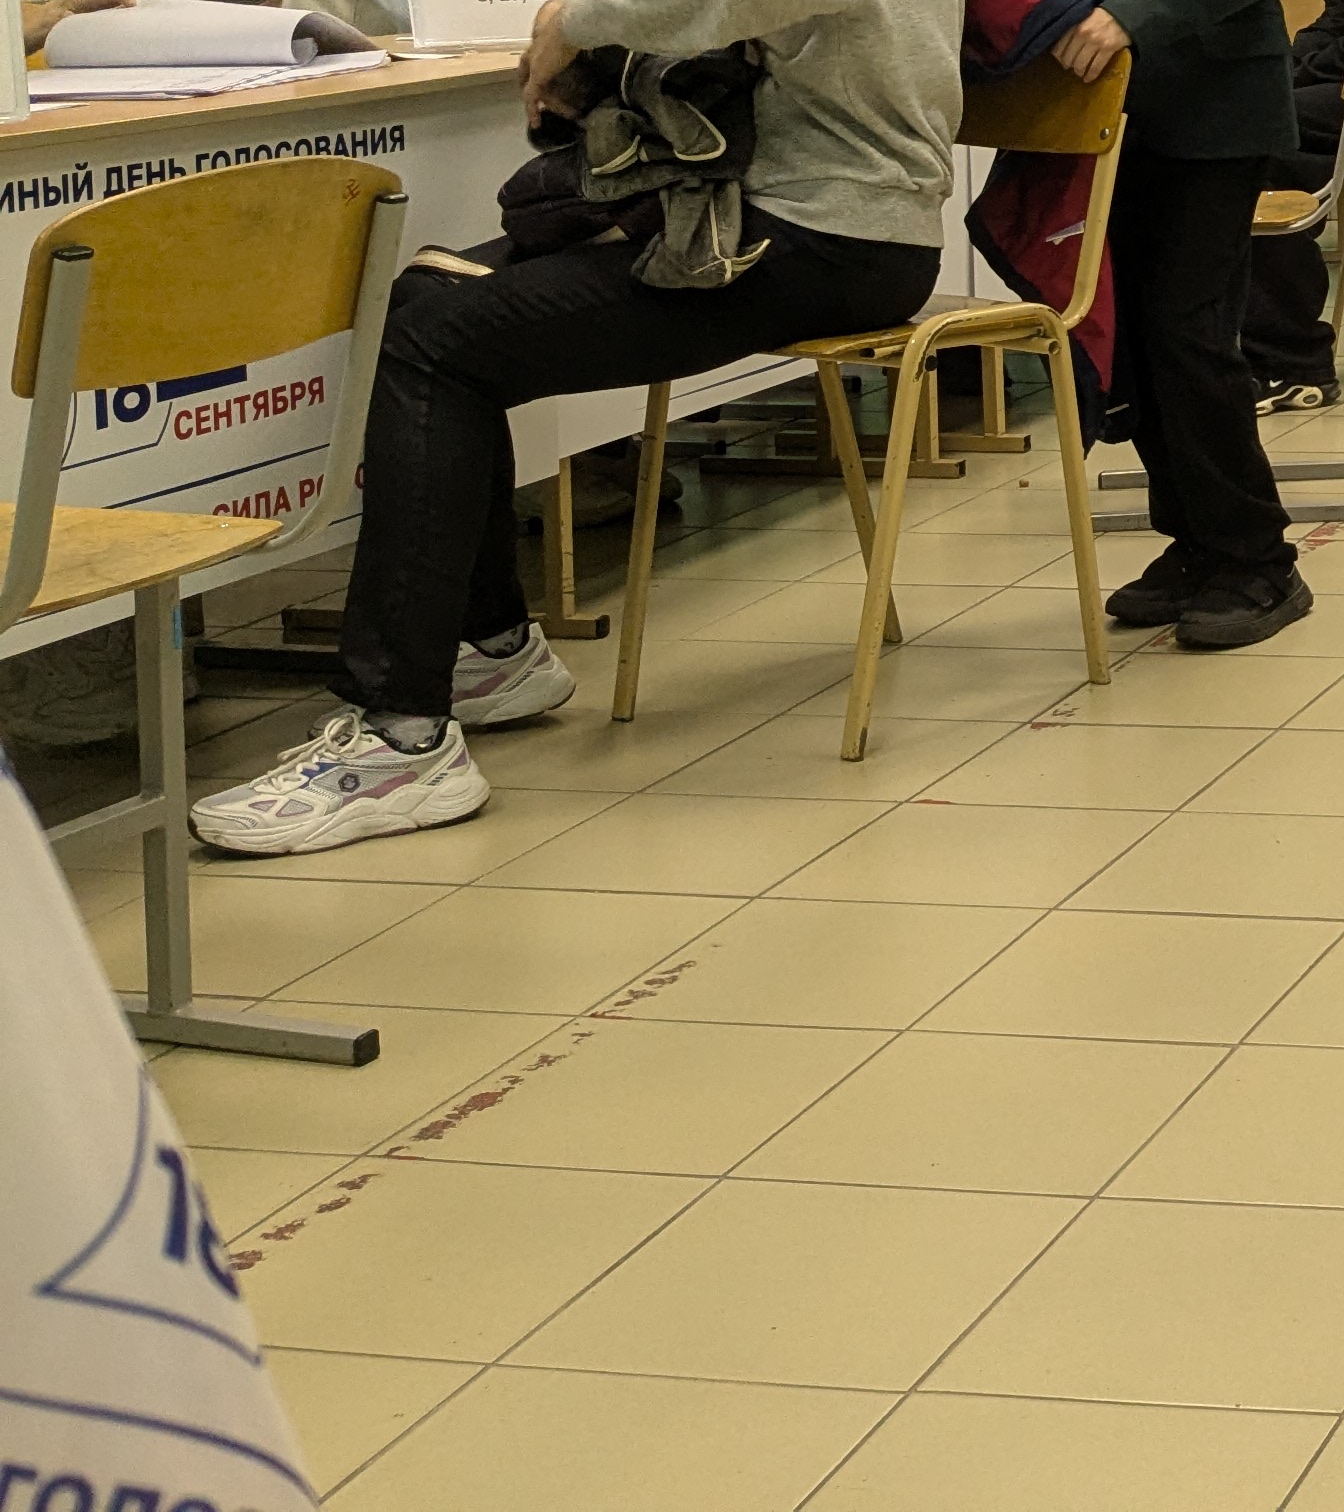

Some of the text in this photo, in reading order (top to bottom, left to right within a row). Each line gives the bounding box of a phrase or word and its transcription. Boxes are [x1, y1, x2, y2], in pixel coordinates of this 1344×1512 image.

[103, 157, 187, 199] ДЕНЬ
[195, 124, 406, 174] ГОЛОСОВАНИЯ
[174, 376, 325, 441] СЕНТЯБРЯ
